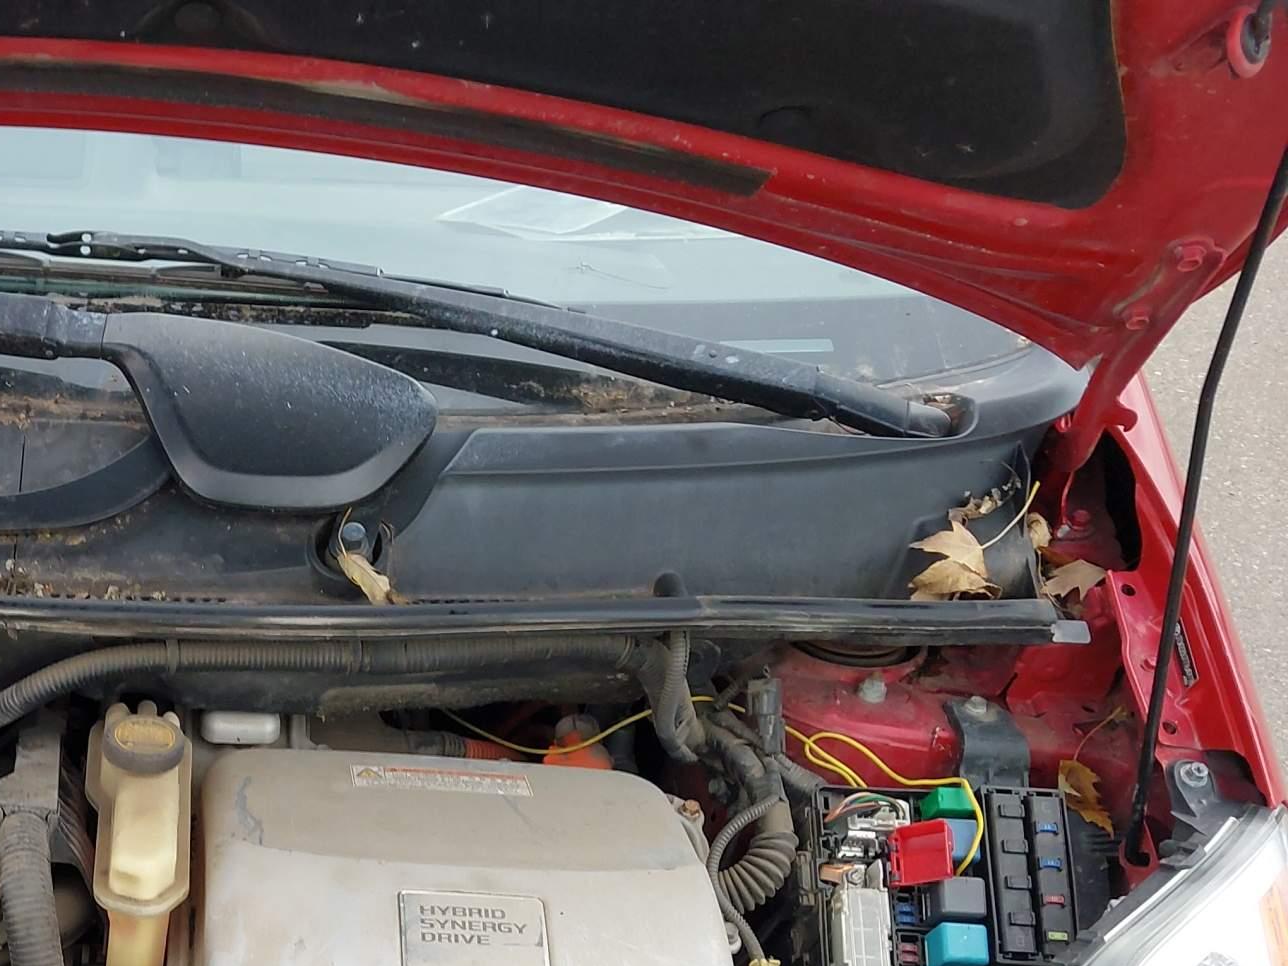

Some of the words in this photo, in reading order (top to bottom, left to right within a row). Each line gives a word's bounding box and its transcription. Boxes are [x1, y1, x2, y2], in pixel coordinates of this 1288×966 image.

[419, 905, 506, 919] HYBRID
[419, 918, 527, 934] SYNERGY
[420, 932, 490, 945] DRIVE
